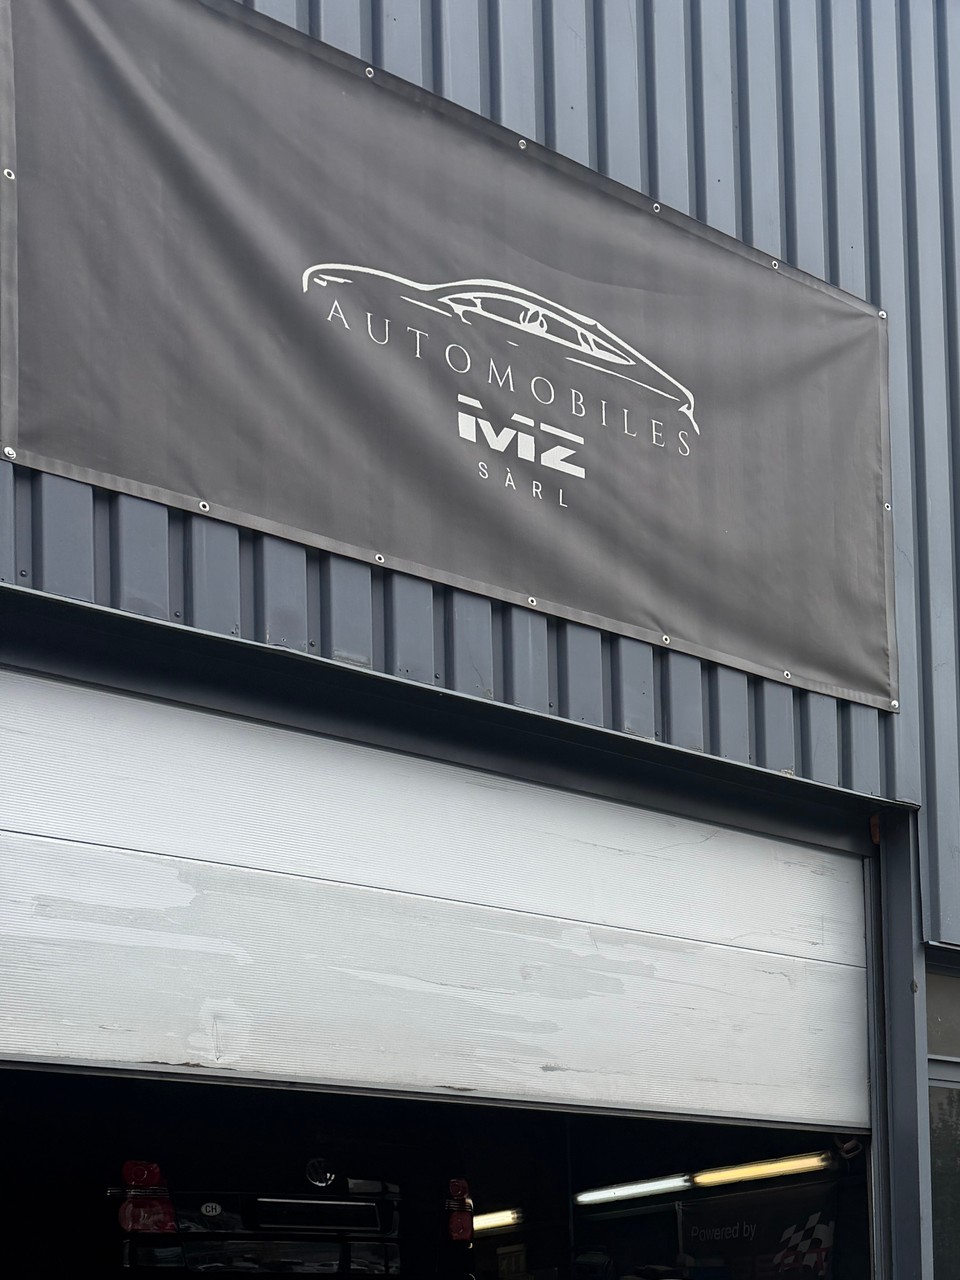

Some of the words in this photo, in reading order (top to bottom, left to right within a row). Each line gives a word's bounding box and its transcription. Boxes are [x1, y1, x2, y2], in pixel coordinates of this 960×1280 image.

[326, 299, 691, 457] AUTOMOBILES
[457, 393, 586, 479] MZ
[478, 461, 568, 508] SÀRL
[690, 1222, 740, 1242] Powered
[743, 1220, 757, 1241] by
